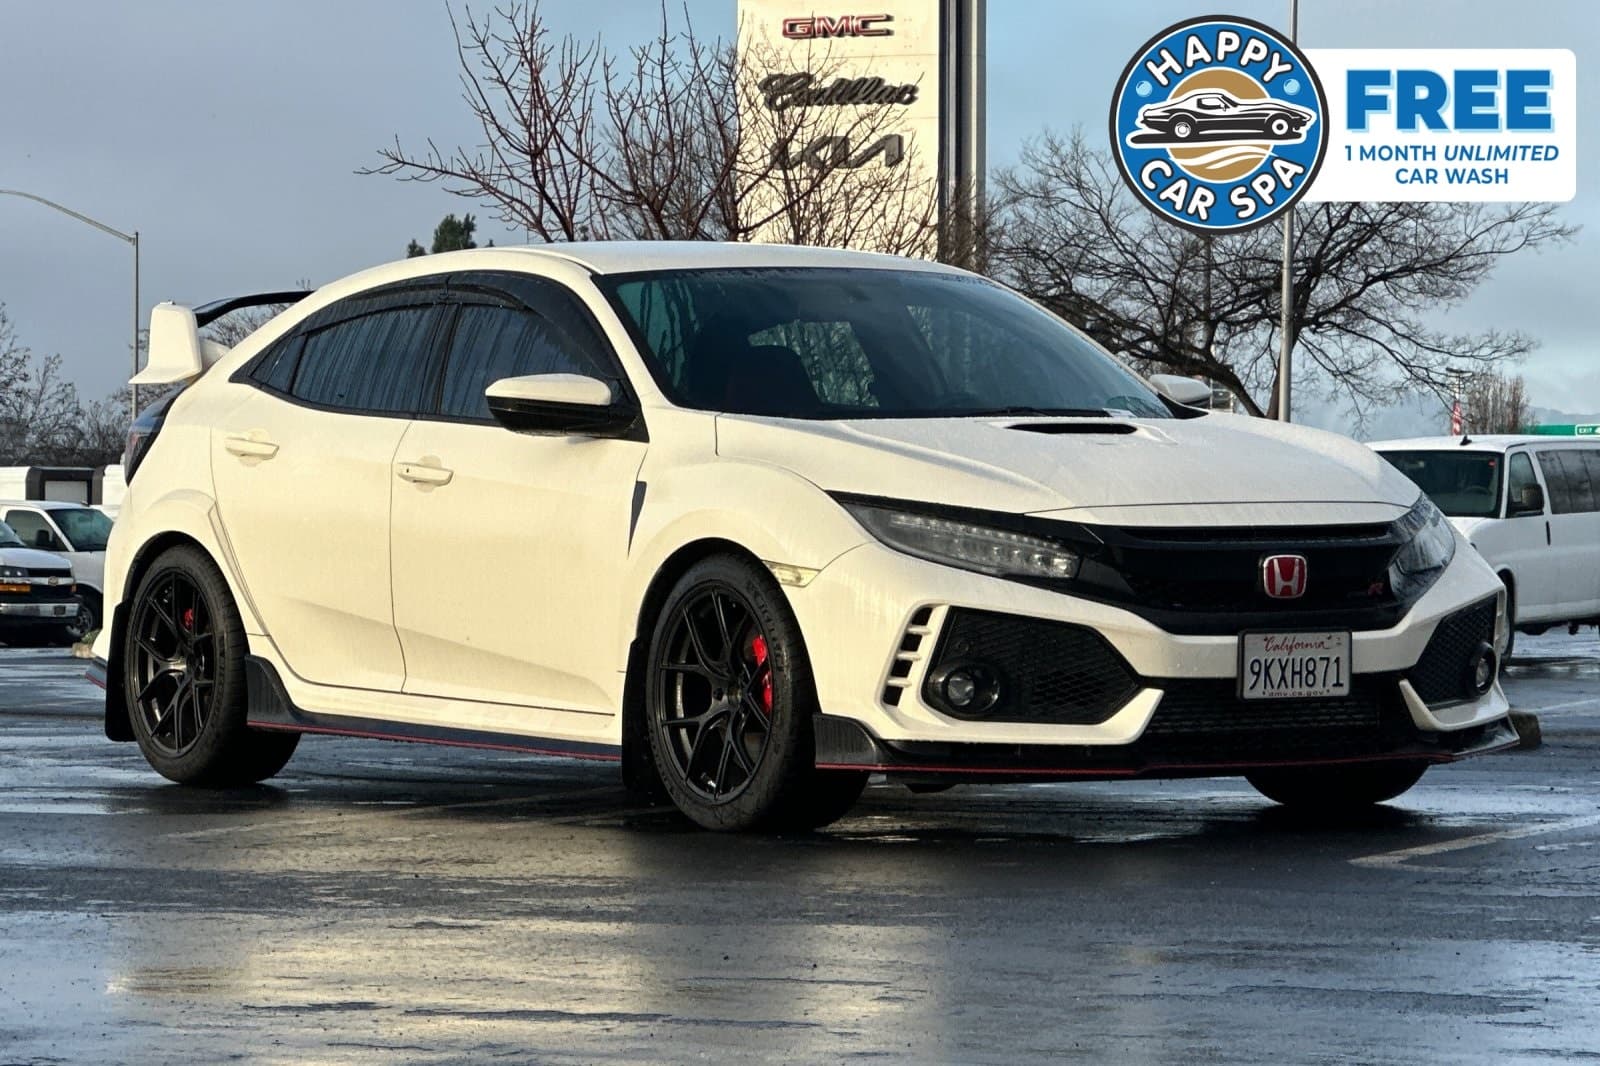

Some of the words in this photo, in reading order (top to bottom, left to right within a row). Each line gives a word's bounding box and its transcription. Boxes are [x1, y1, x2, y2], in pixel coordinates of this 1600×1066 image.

[782, 14, 895, 39] GMC
[1264, 637, 1330, 655] California
[1249, 656, 1344, 690] 9KXH871
